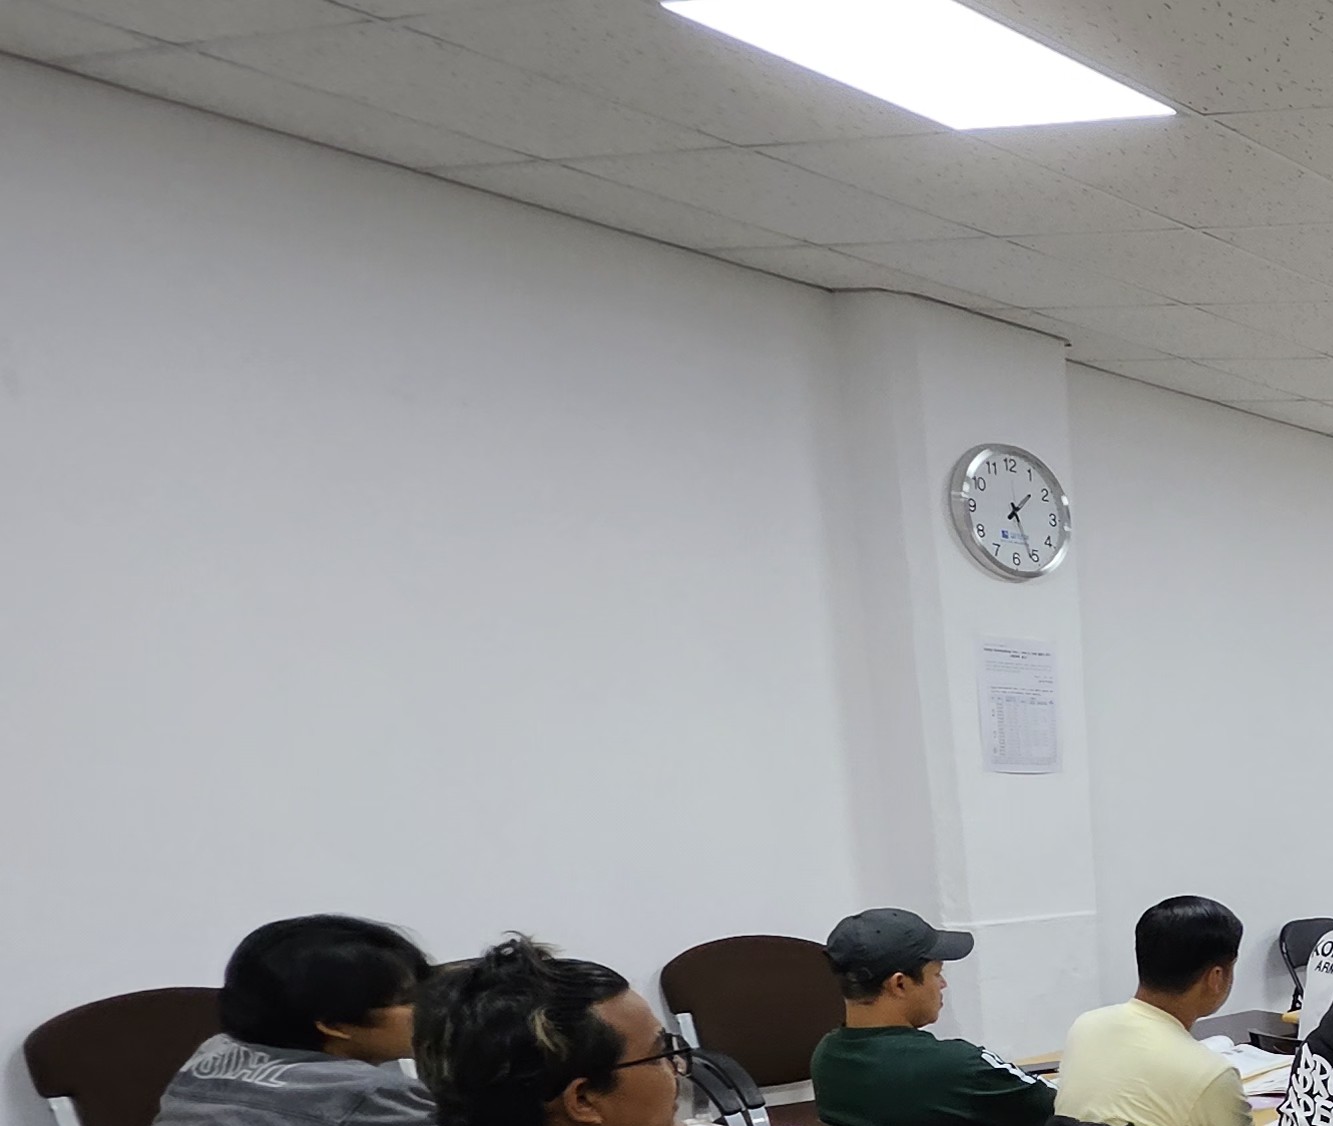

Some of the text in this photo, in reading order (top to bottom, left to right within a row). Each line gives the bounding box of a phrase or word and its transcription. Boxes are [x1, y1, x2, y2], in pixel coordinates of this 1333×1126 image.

[986, 461, 997, 475] 11
[1003, 457, 1017, 473] 12
[1027, 468, 1032, 482] 1
[972, 476, 986, 491] 10
[1040, 488, 1049, 502] 2
[968, 498, 976, 512] 9
[1048, 513, 1057, 527] 3
[976, 524, 985, 538] 8
[1044, 536, 1053, 547] 4
[992, 543, 1000, 556] 7
[1031, 549, 1039, 563] 5
[1013, 552, 1021, 566] 6
